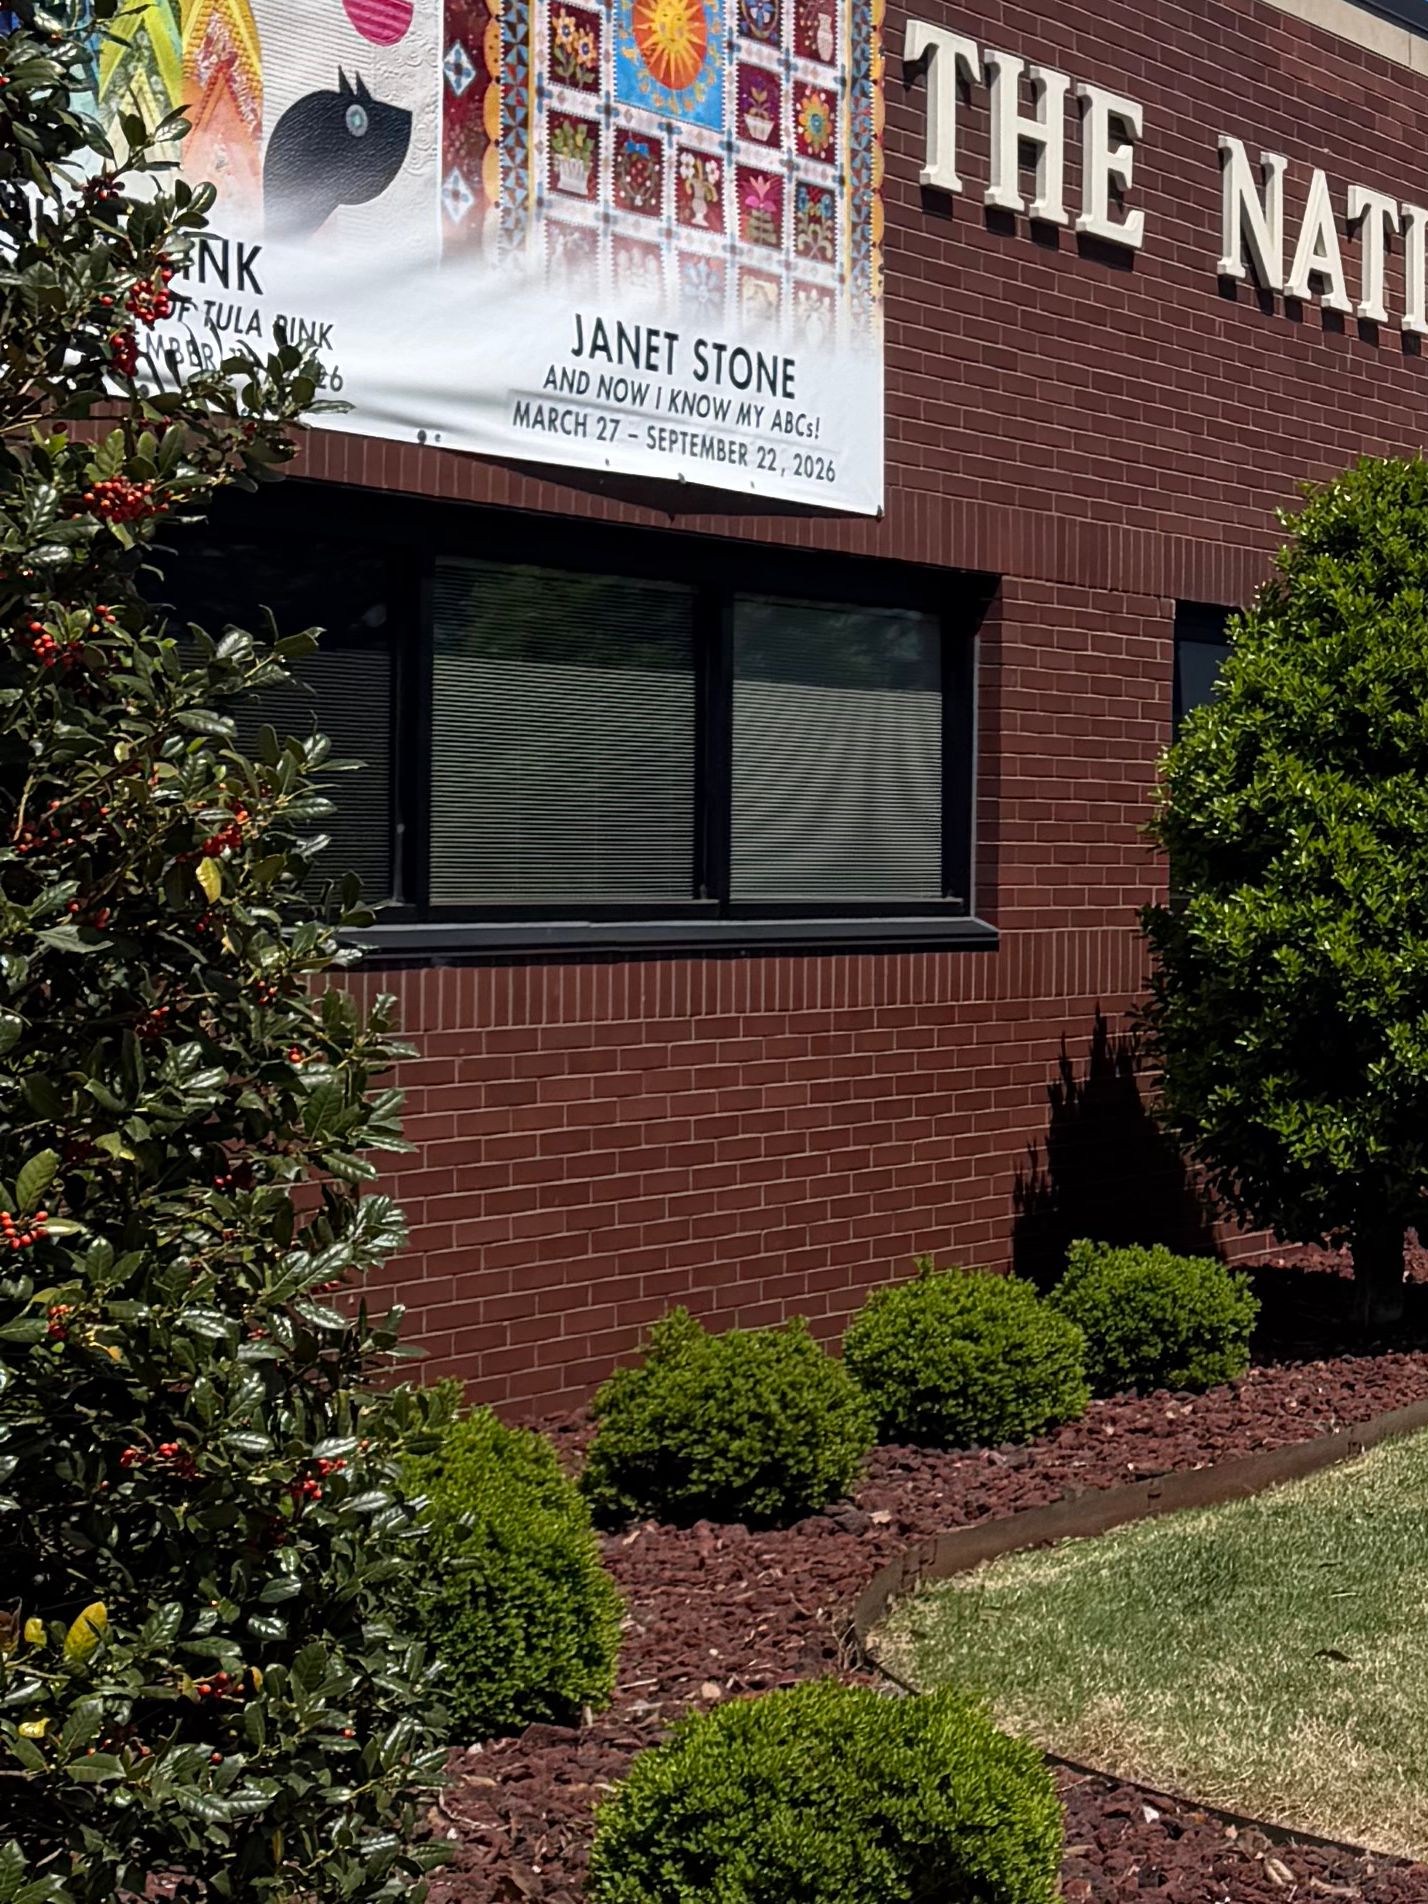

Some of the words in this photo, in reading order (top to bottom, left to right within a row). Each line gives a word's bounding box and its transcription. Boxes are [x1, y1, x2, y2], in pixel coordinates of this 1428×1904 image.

[904, 19, 1144, 250] THE
[204, 299, 263, 338] TULA
[570, 313, 679, 375] JANET
[692, 338, 796, 400] STONE
[513, 401, 588, 438] MARCH
[596, 416, 620, 442] 27
[646, 425, 748, 466] SEPTEMBER
[756, 447, 785, 477] 22,
[793, 453, 836, 483] 2026
[543, 364, 590, 395] AND
[596, 374, 650, 409] NOW
[655, 387, 662, 410] I
[668, 389, 732, 423] KNOW
[736, 401, 764, 428] MY
[771, 409, 820, 440] ABCs!
